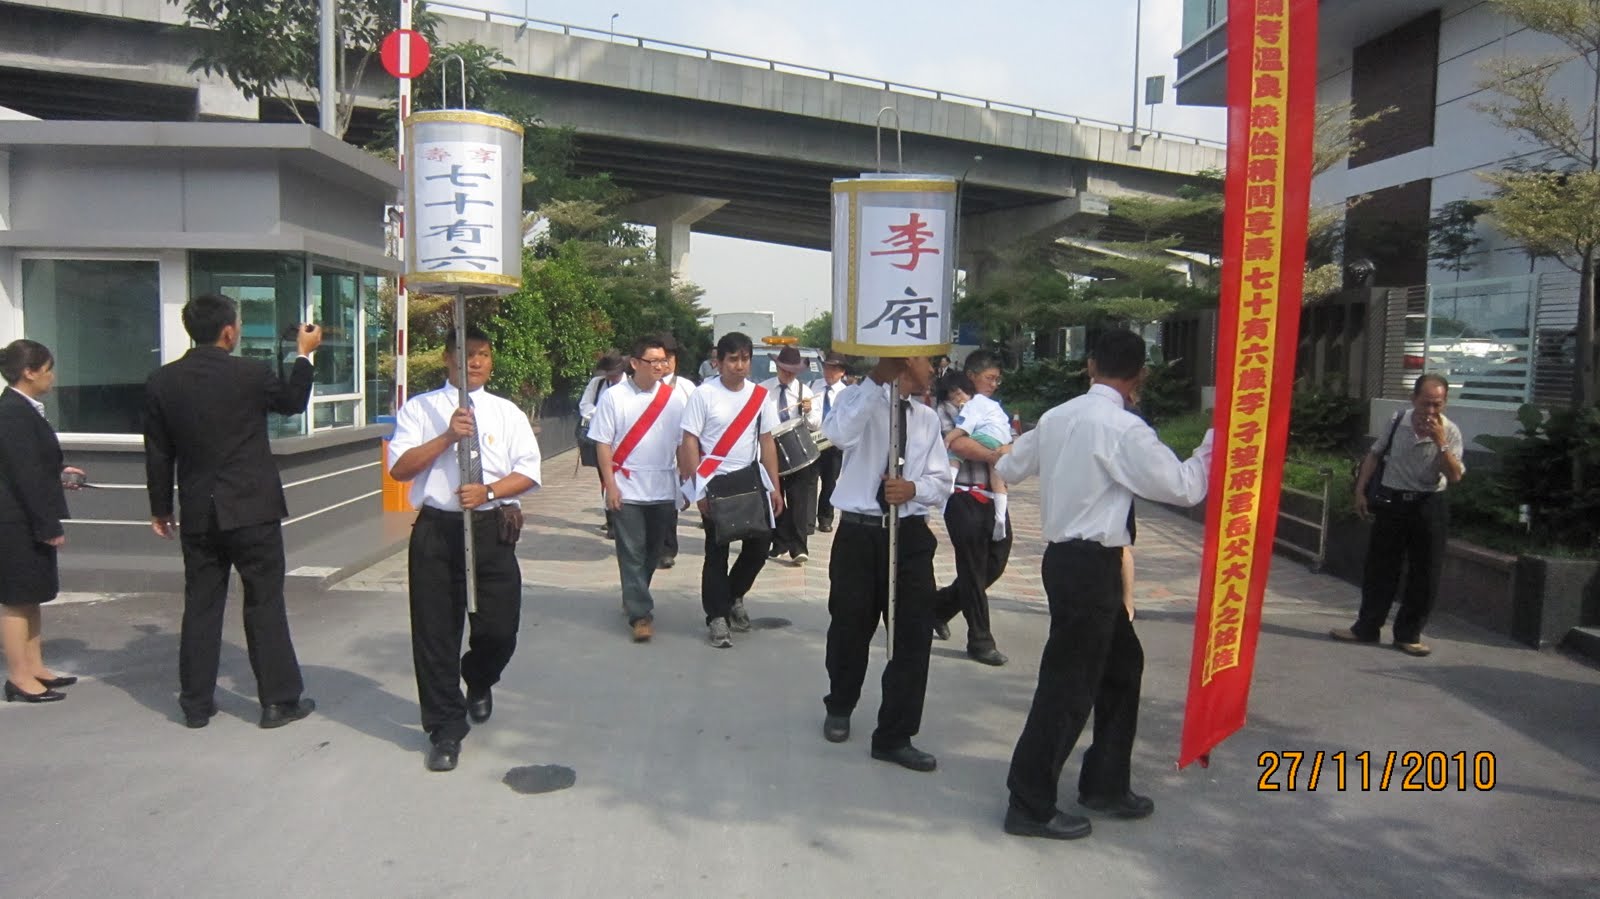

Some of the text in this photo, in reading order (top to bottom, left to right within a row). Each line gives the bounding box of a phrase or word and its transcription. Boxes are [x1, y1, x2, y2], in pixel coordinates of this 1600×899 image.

[421, 164, 499, 271] 七十有六
[861, 212, 940, 341] 李府
